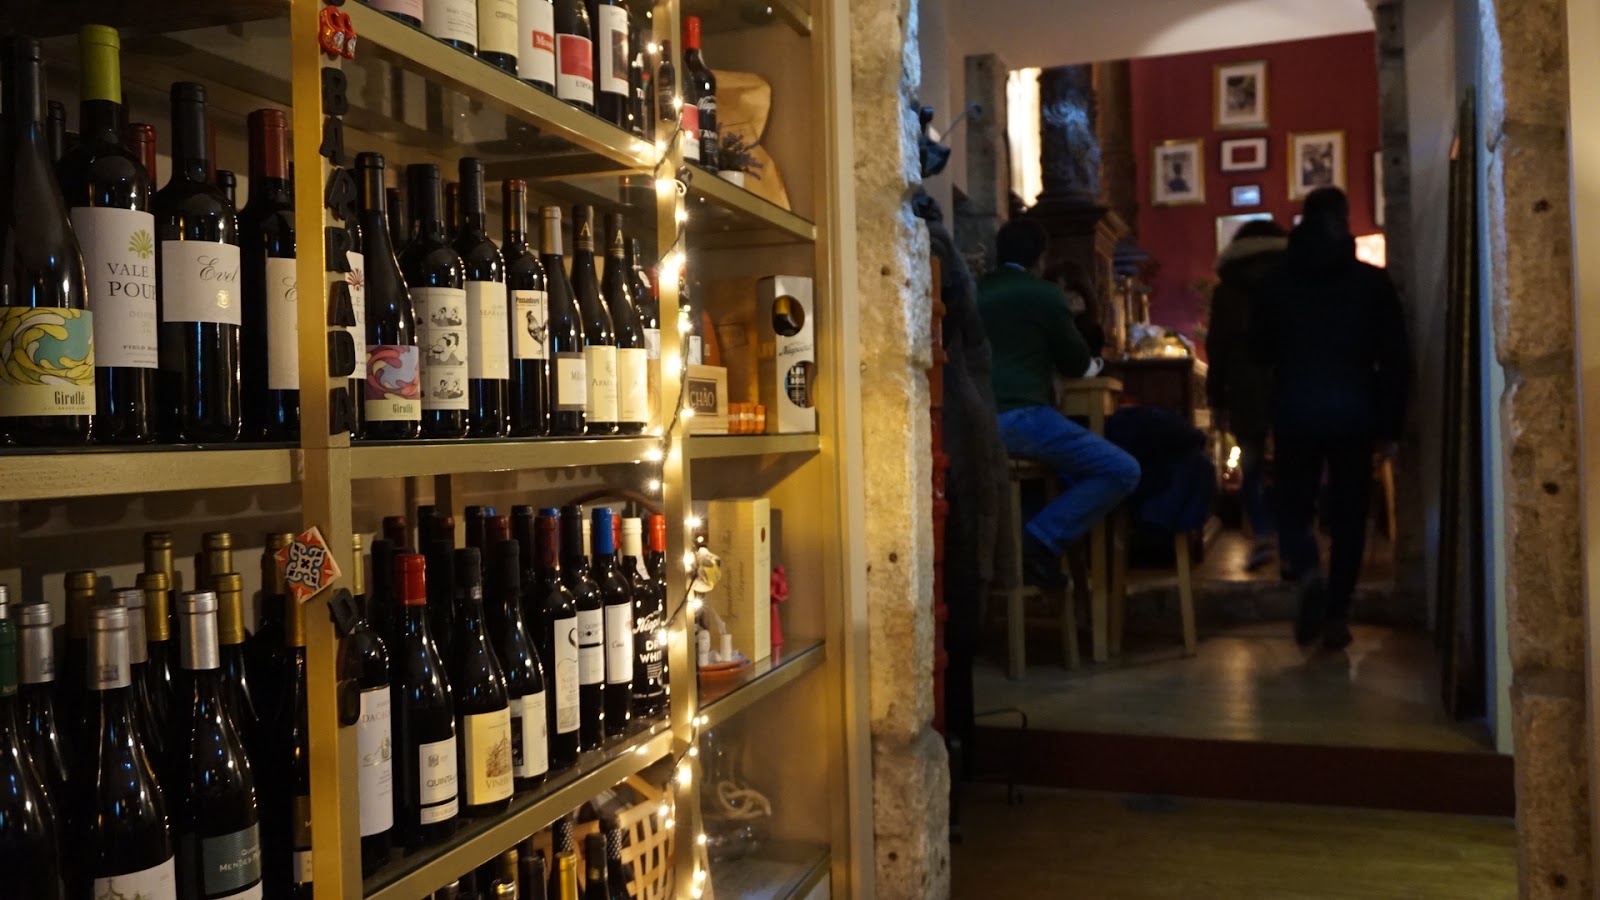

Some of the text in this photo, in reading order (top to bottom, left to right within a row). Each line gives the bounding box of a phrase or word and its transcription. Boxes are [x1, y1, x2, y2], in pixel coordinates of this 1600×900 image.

[580, 221, 591, 237] A
[614, 229, 624, 244] A
[107, 262, 149, 278] VALE
[196, 255, 239, 283] Evel
